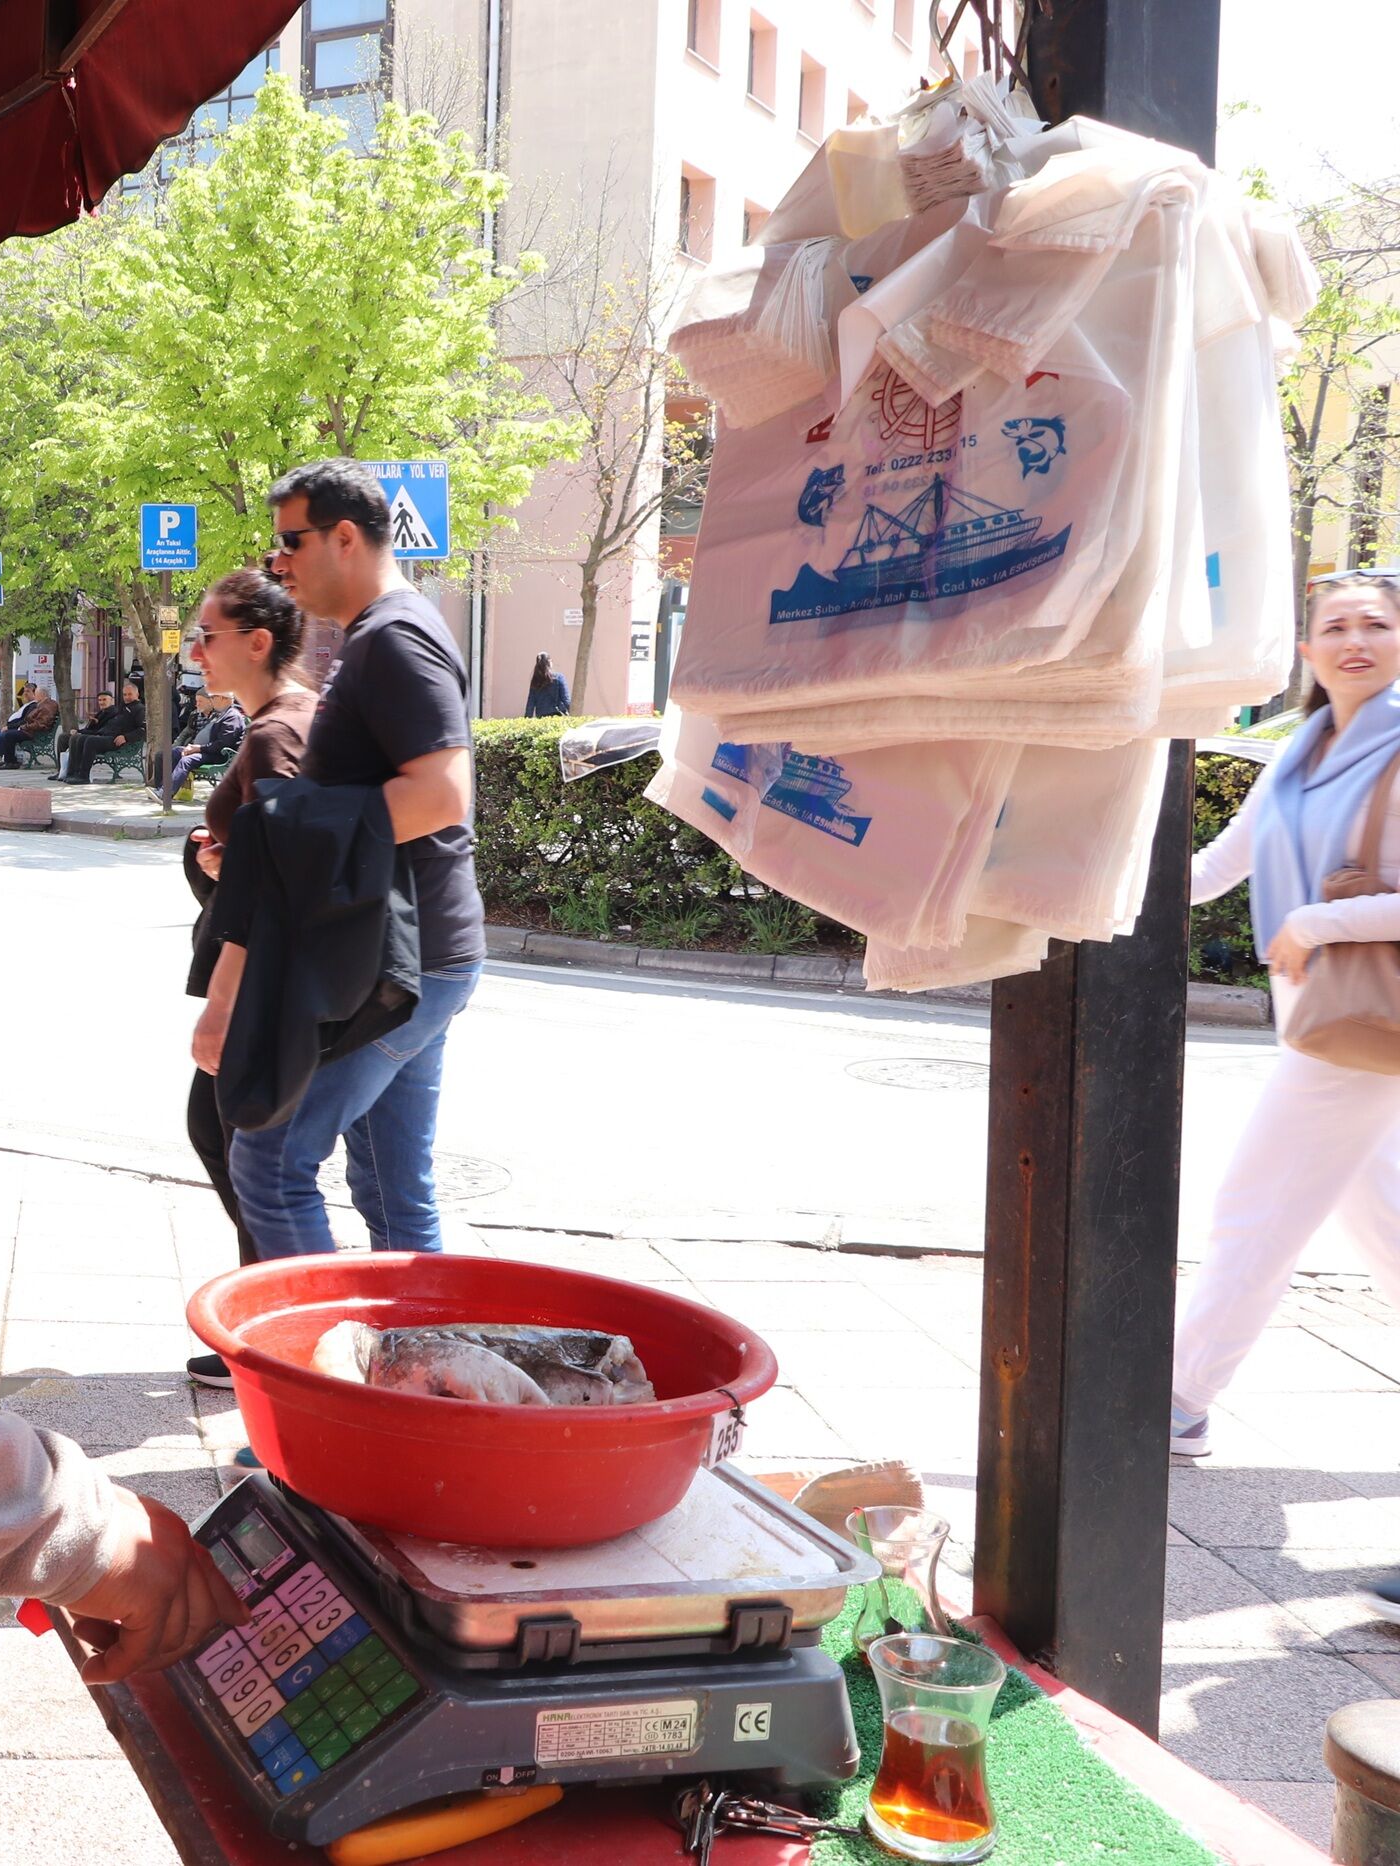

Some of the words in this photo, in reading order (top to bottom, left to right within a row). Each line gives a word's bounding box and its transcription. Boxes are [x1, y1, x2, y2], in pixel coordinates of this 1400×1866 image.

[409, 464, 426, 478] YOL
[429, 464, 445, 478] VER
[891, 455, 923, 471] 0222
[160, 511, 180, 538] P
[777, 608, 813, 619] Merkez
[815, 605, 841, 616] Şube
[942, 580, 968, 593] Cad.
[715, 1421, 738, 1463] 255
[288, 1575, 312, 1595] 1
[300, 1590, 327, 1614] 2
[316, 1608, 342, 1630] 3
[251, 1609, 273, 1628] 4
[260, 1624, 287, 1646] 5
[274, 1643, 300, 1667] 6
[206, 1640, 232, 1663] 7
[219, 1660, 244, 1684] 8
[233, 1679, 258, 1702] 9
[247, 1700, 273, 1725] 0
[292, 1664, 312, 1685] C
[543, 1712, 571, 1722] HANA
[663, 1731, 683, 1740] 1783
